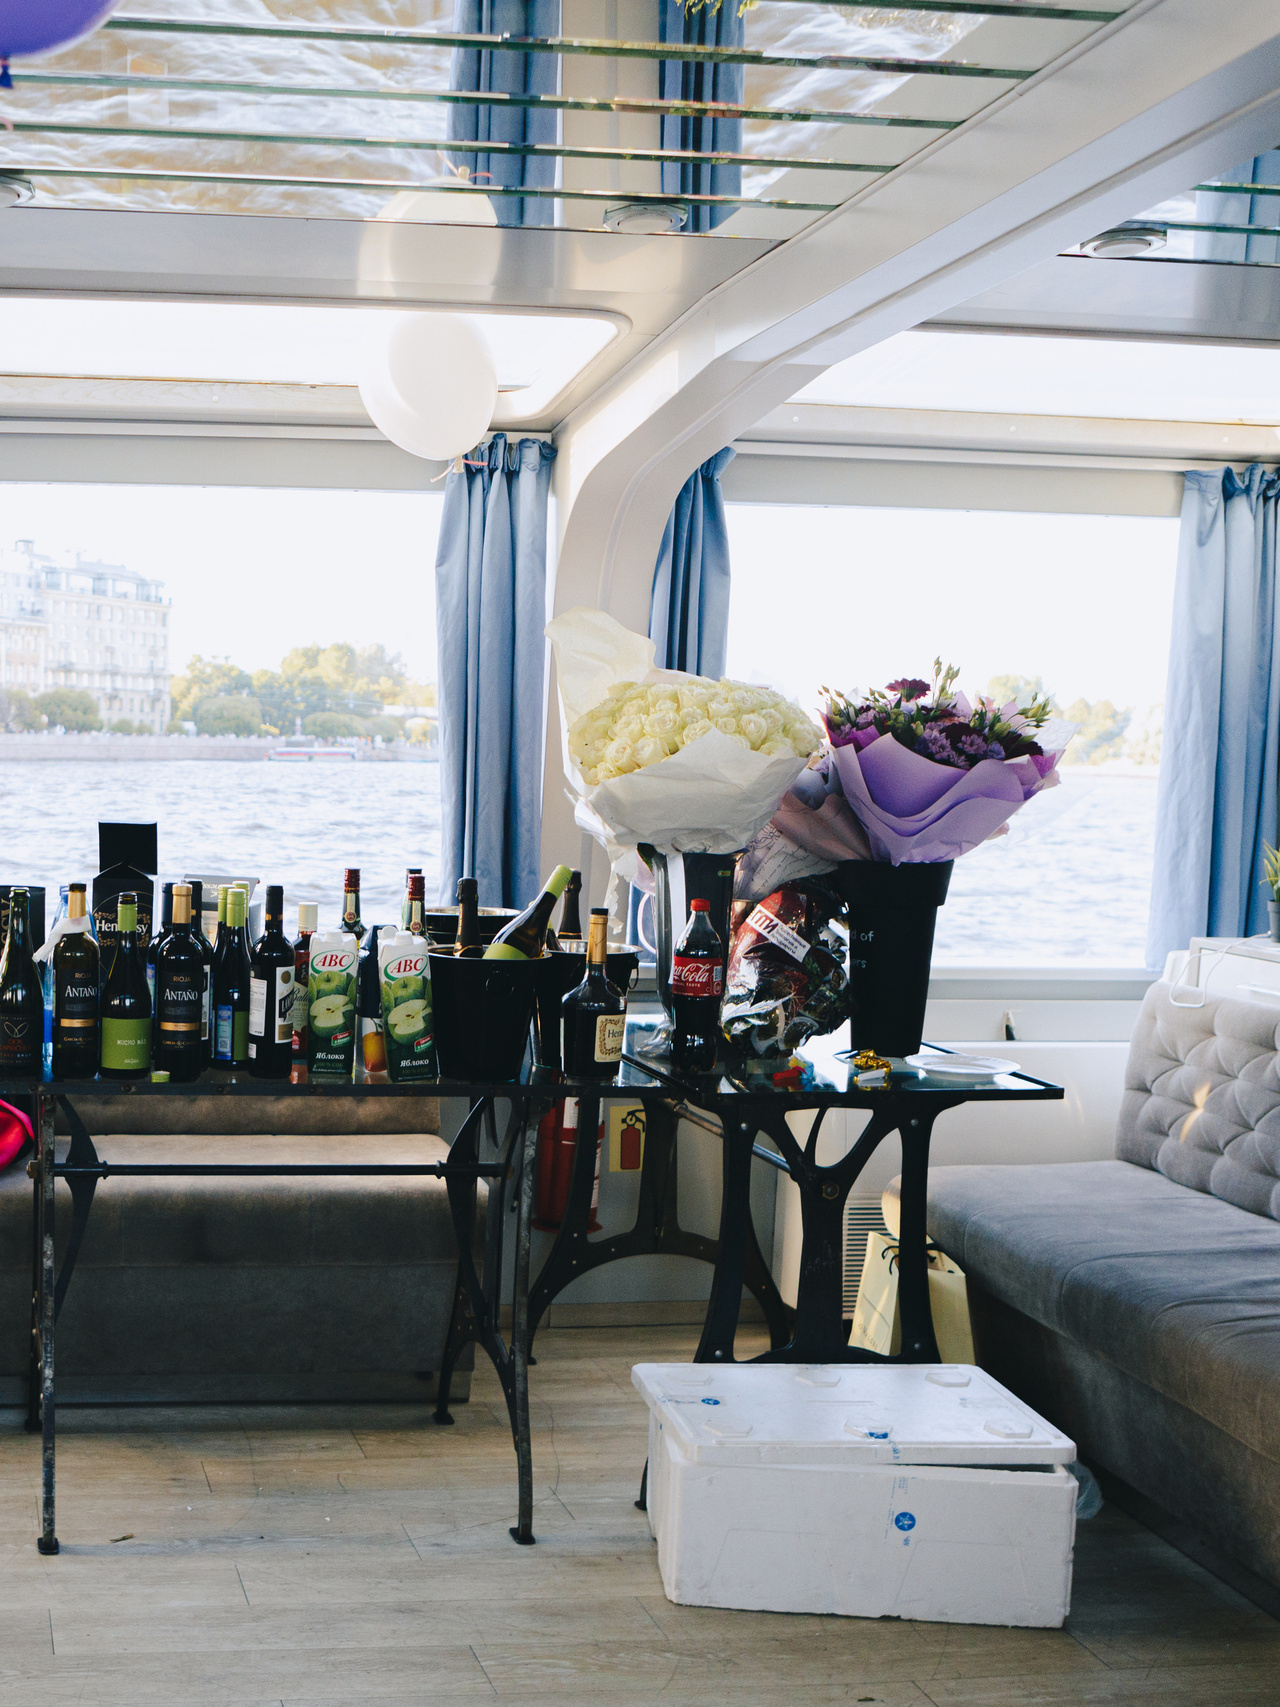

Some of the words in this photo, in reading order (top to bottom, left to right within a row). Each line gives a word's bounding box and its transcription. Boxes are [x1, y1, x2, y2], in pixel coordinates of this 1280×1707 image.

[96, 919, 149, 935] Hensy
[860, 931, 874, 942] of
[316, 953, 350, 967] ABC
[390, 957, 424, 974] ABC
[674, 963, 712, 982] ca-Cola
[65, 985, 98, 997] ANTAÑO
[164, 988, 198, 1001] ANTAÑO
[315, 1052, 345, 1060] Яблоко
[400, 1058, 429, 1067] Яблоко
